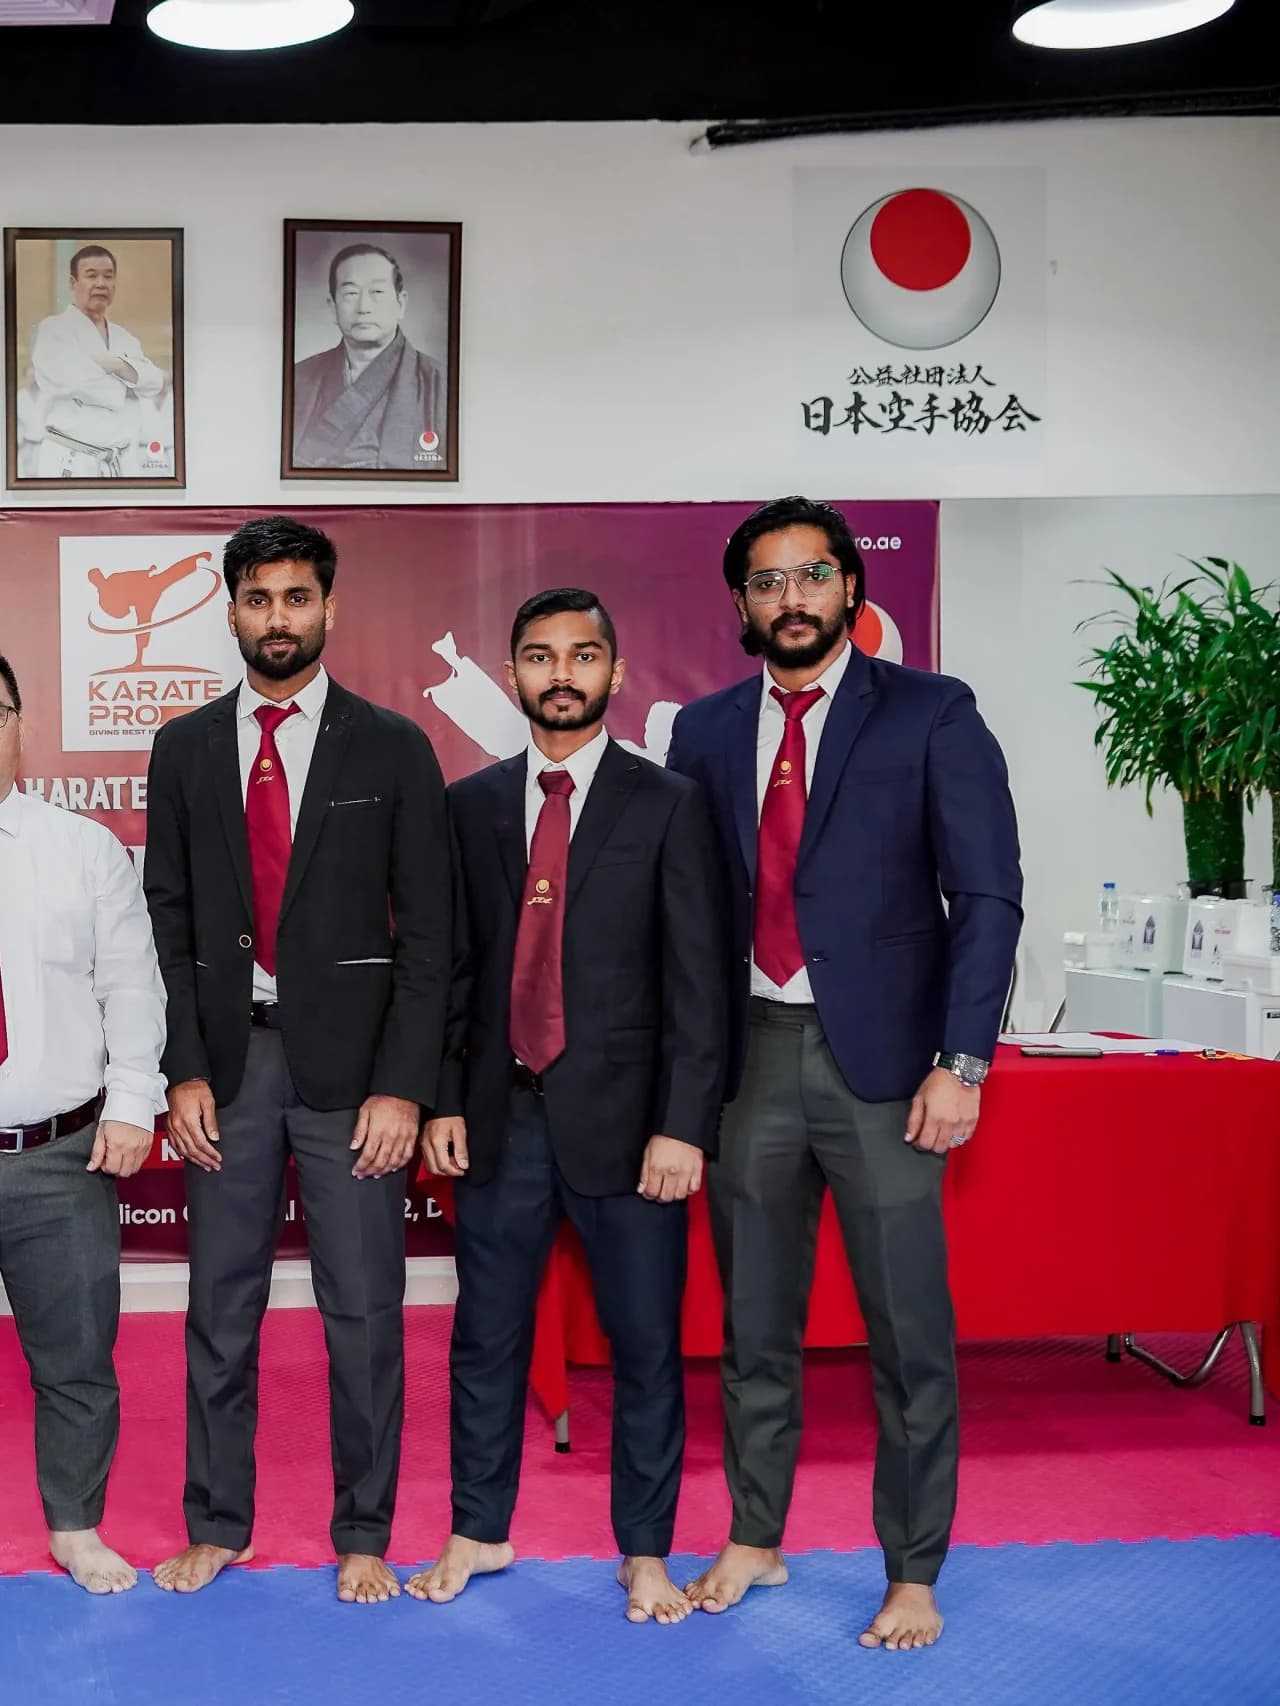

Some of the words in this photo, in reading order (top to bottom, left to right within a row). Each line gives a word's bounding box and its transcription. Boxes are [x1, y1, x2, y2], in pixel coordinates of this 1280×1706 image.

[848, 363, 997, 388] 公益社団法人
[801, 391, 1042, 436] 日本空手協会
[89, 680, 223, 701] KARATE
[89, 705, 159, 726] PRO
